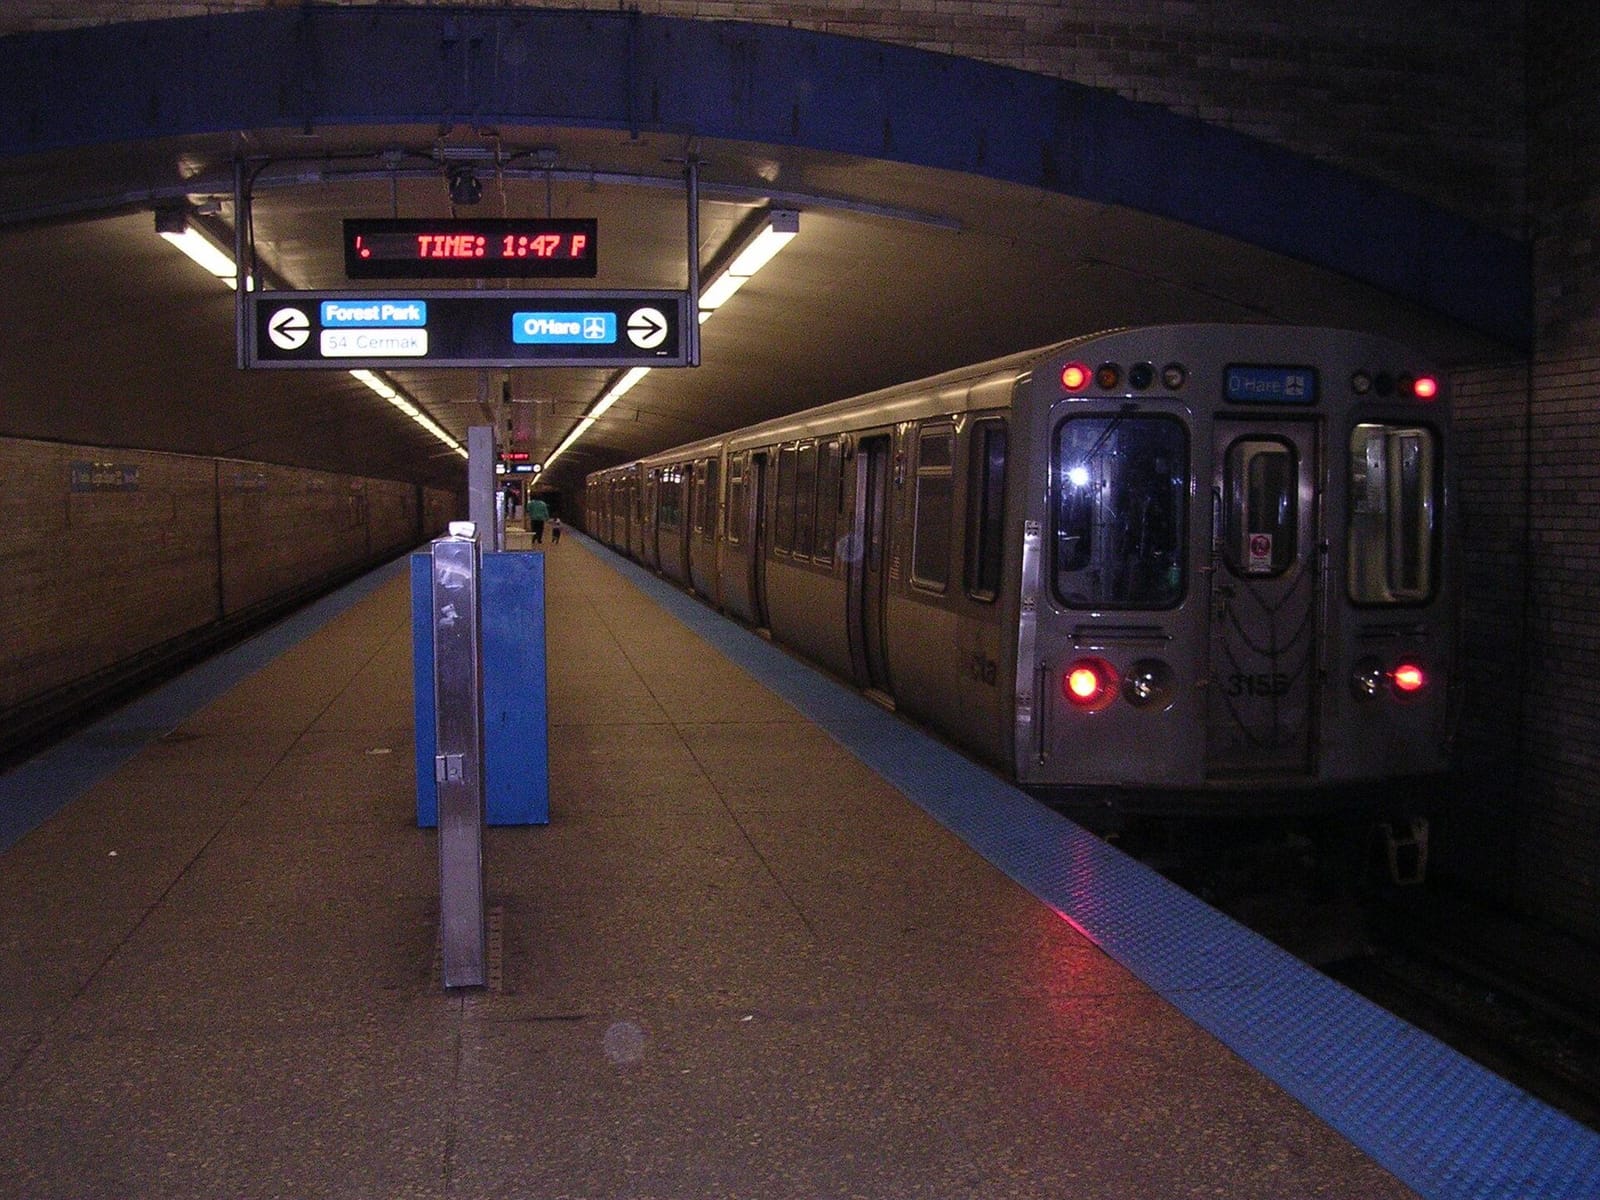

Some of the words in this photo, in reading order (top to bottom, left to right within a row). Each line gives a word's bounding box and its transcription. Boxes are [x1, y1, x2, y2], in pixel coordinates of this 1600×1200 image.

[418, 235, 485, 257] TIME:
[502, 235, 560, 257] 1:47
[326, 304, 380, 321] Forest
[381, 304, 420, 320] Park
[524, 318, 581, 335] O'Hare
[328, 335, 348, 350] 54
[356, 334, 418, 350] Cermak
